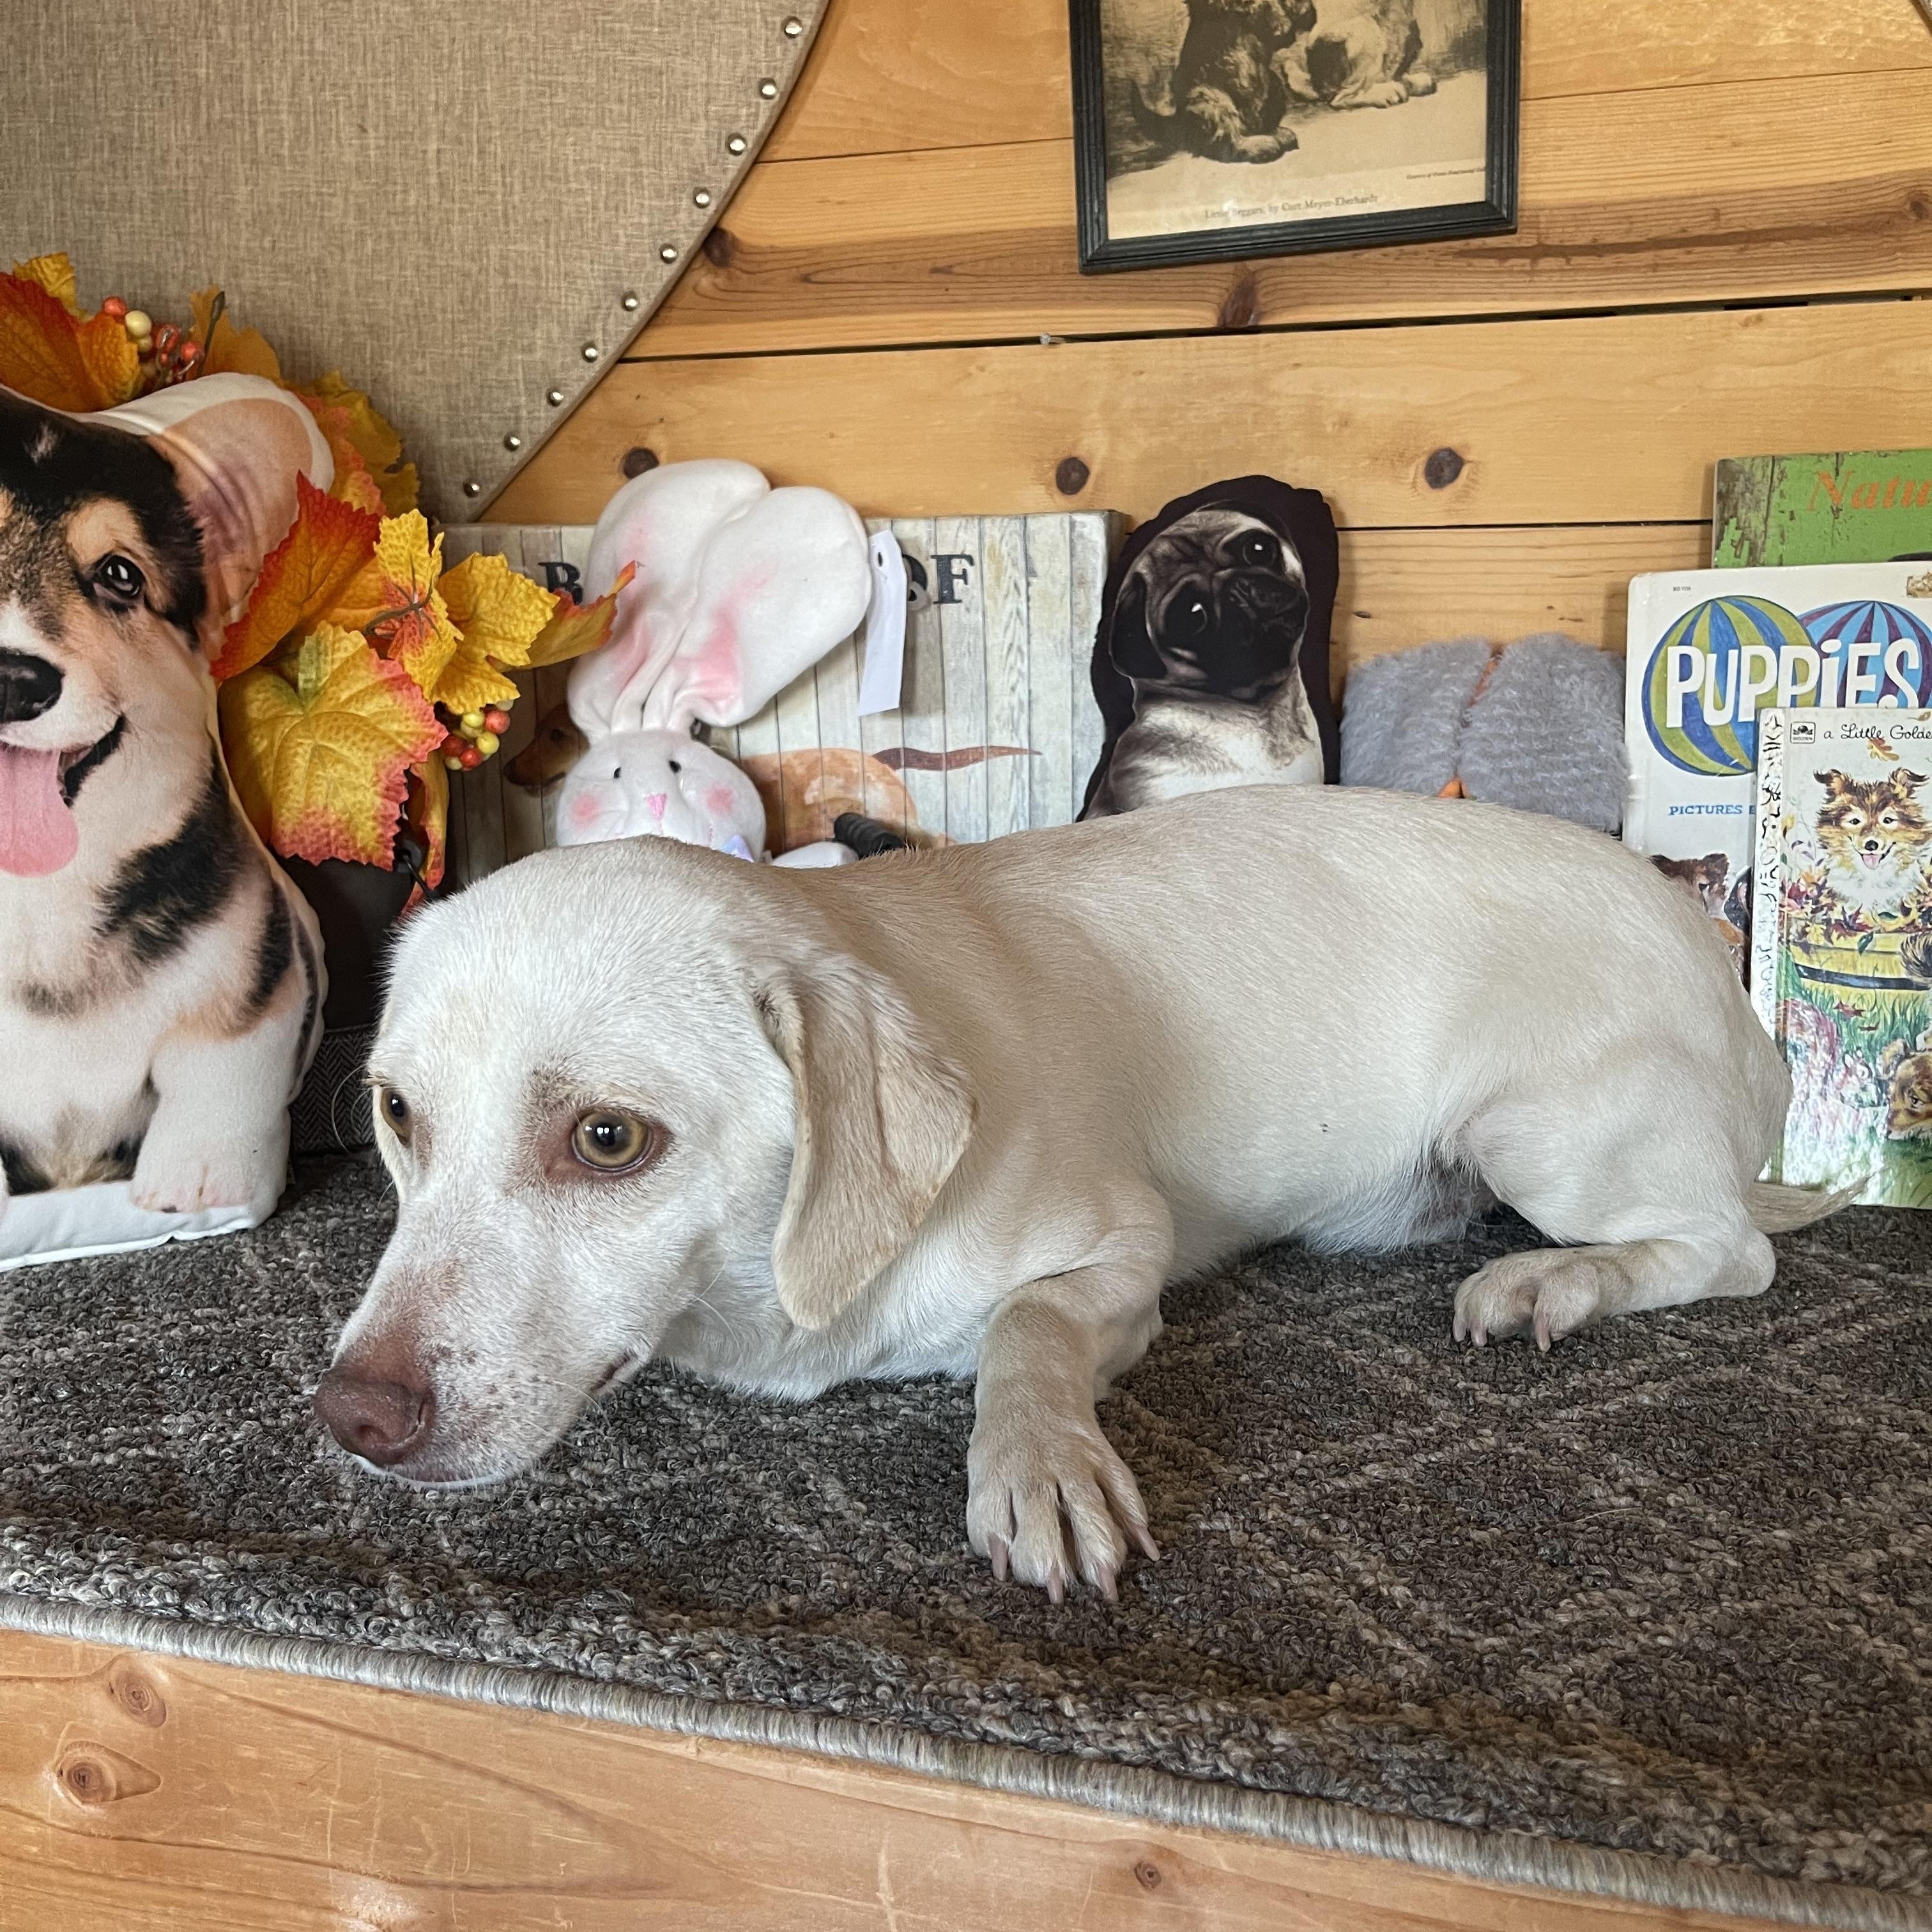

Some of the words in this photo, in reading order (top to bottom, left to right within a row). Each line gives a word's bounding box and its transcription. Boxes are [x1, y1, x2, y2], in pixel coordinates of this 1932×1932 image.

[1823, 730, 1834, 739] a
[1841, 723, 1884, 740] Little
[1668, 804, 1742, 816] PICTURES
